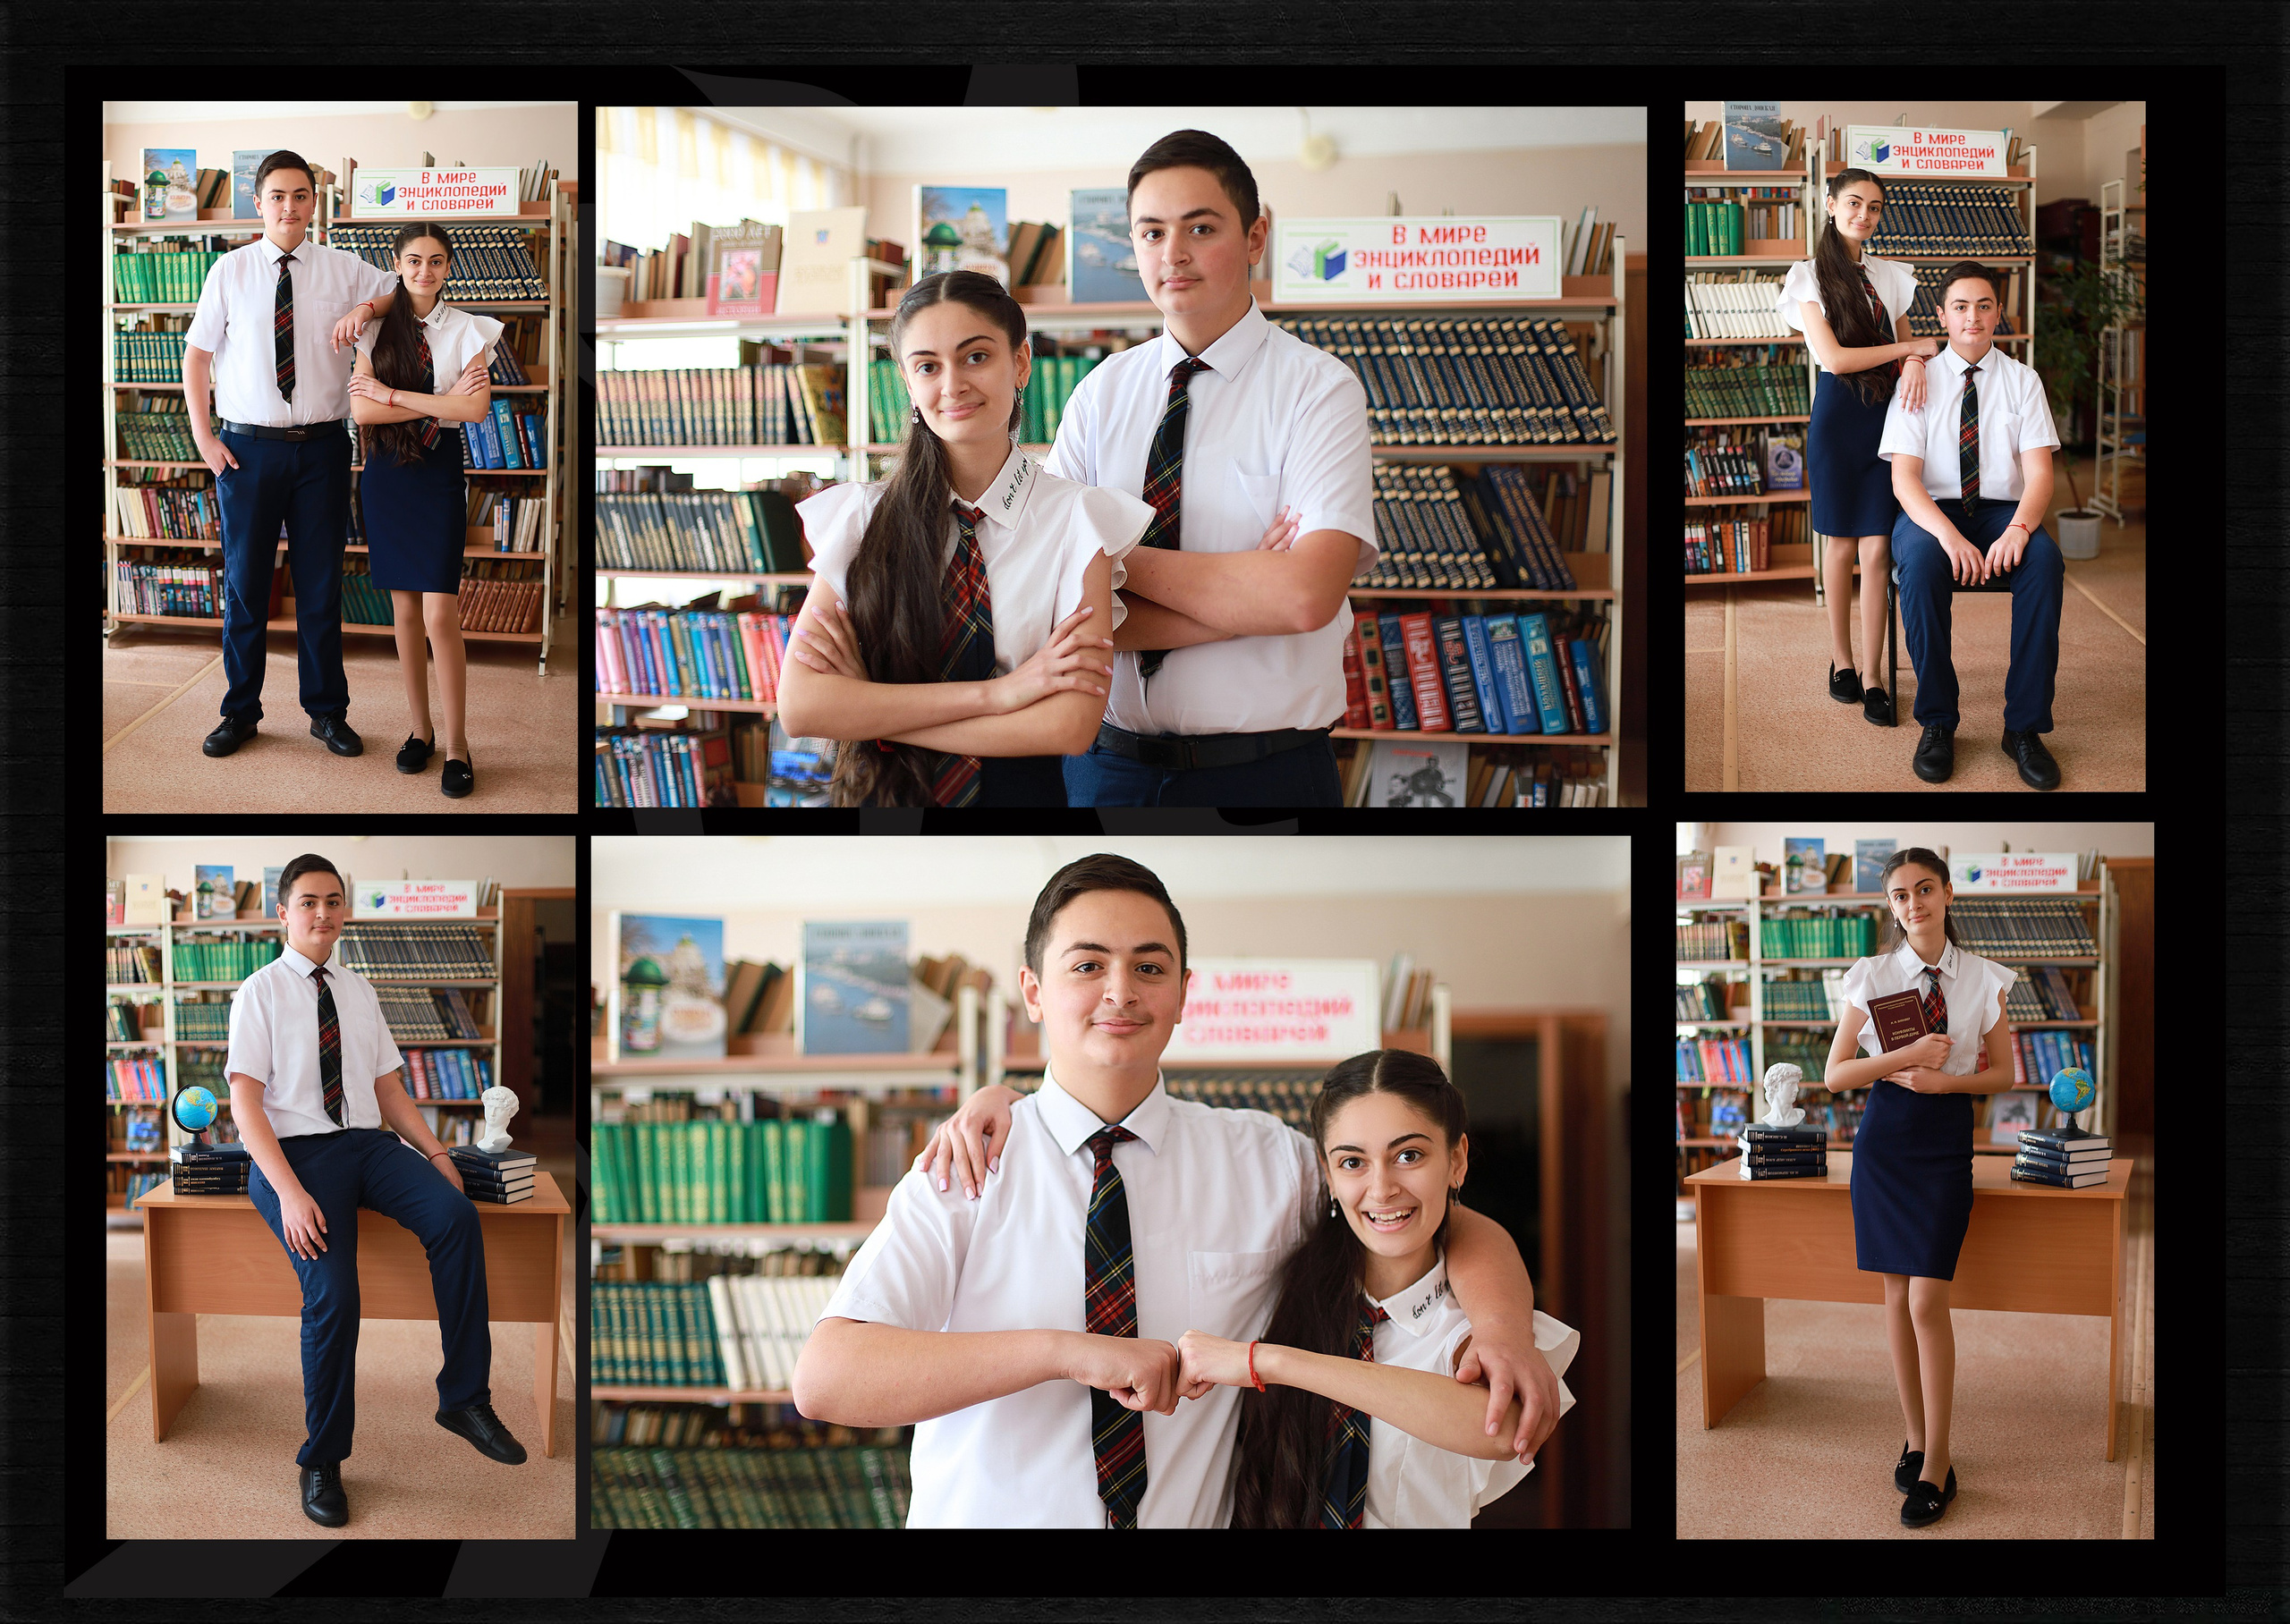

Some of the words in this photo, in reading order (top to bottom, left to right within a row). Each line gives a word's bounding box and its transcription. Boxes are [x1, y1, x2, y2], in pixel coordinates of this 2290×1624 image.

[1913, 131, 1922, 144] В
[1929, 133, 1965, 145] МИРЕ
[1893, 145, 1995, 159] ЭНЦИКЛОПЕДИЙ
[1902, 159, 1910, 169] И
[1916, 158, 1985, 170] СЛОВАРЕЙ
[421, 172, 430, 184] В
[437, 172, 477, 184] МИРЕ
[399, 182, 507, 199] ЭНЦИКЛОПЕДИЙ
[407, 200, 415, 210] И
[421, 198, 494, 210] СЛОВАРЕЙ
[1392, 224, 1407, 245] В
[1420, 225, 1487, 245] МИРЕ
[1353, 242, 1540, 269] ЭНЦИКЛОПЕДИЙ
[1369, 274, 1381, 290] И
[1394, 268, 1519, 291] СЛОВАРЕЙ
